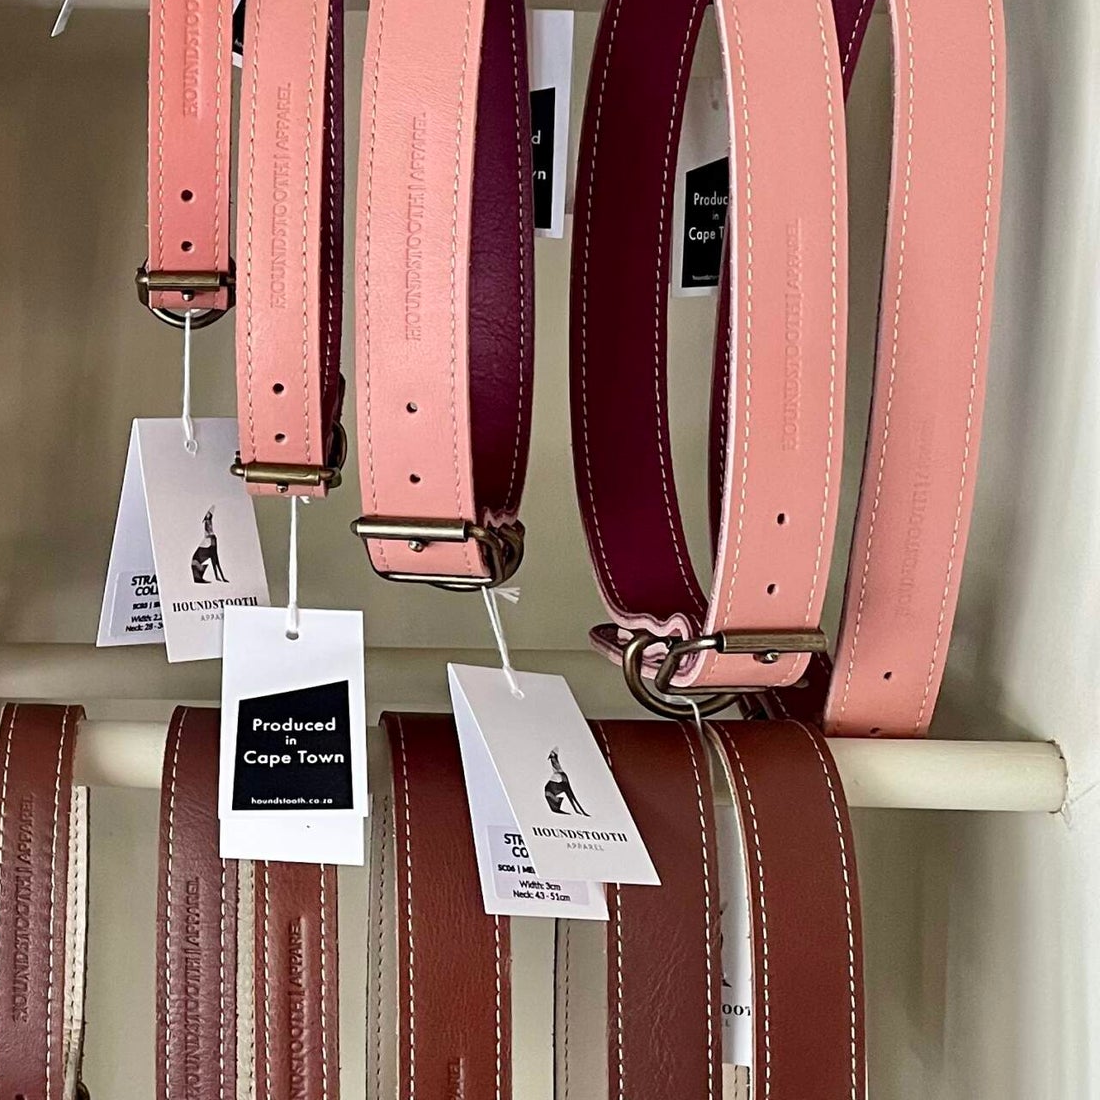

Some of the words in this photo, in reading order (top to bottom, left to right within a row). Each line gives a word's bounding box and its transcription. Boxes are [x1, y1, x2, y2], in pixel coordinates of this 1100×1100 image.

[693, 191, 728, 205] Produc
[688, 227, 716, 244] Cape
[131, 574, 157, 586] STRA
[201, 613, 224, 621] APPA
[252, 717, 336, 731] Produced
[285, 735, 297, 745] in
[243, 750, 291, 768] Cape
[297, 750, 344, 764] Town
[251, 796, 333, 804] houndstooth.co.za
[532, 827, 628, 843] HOUNDSTOOTH
